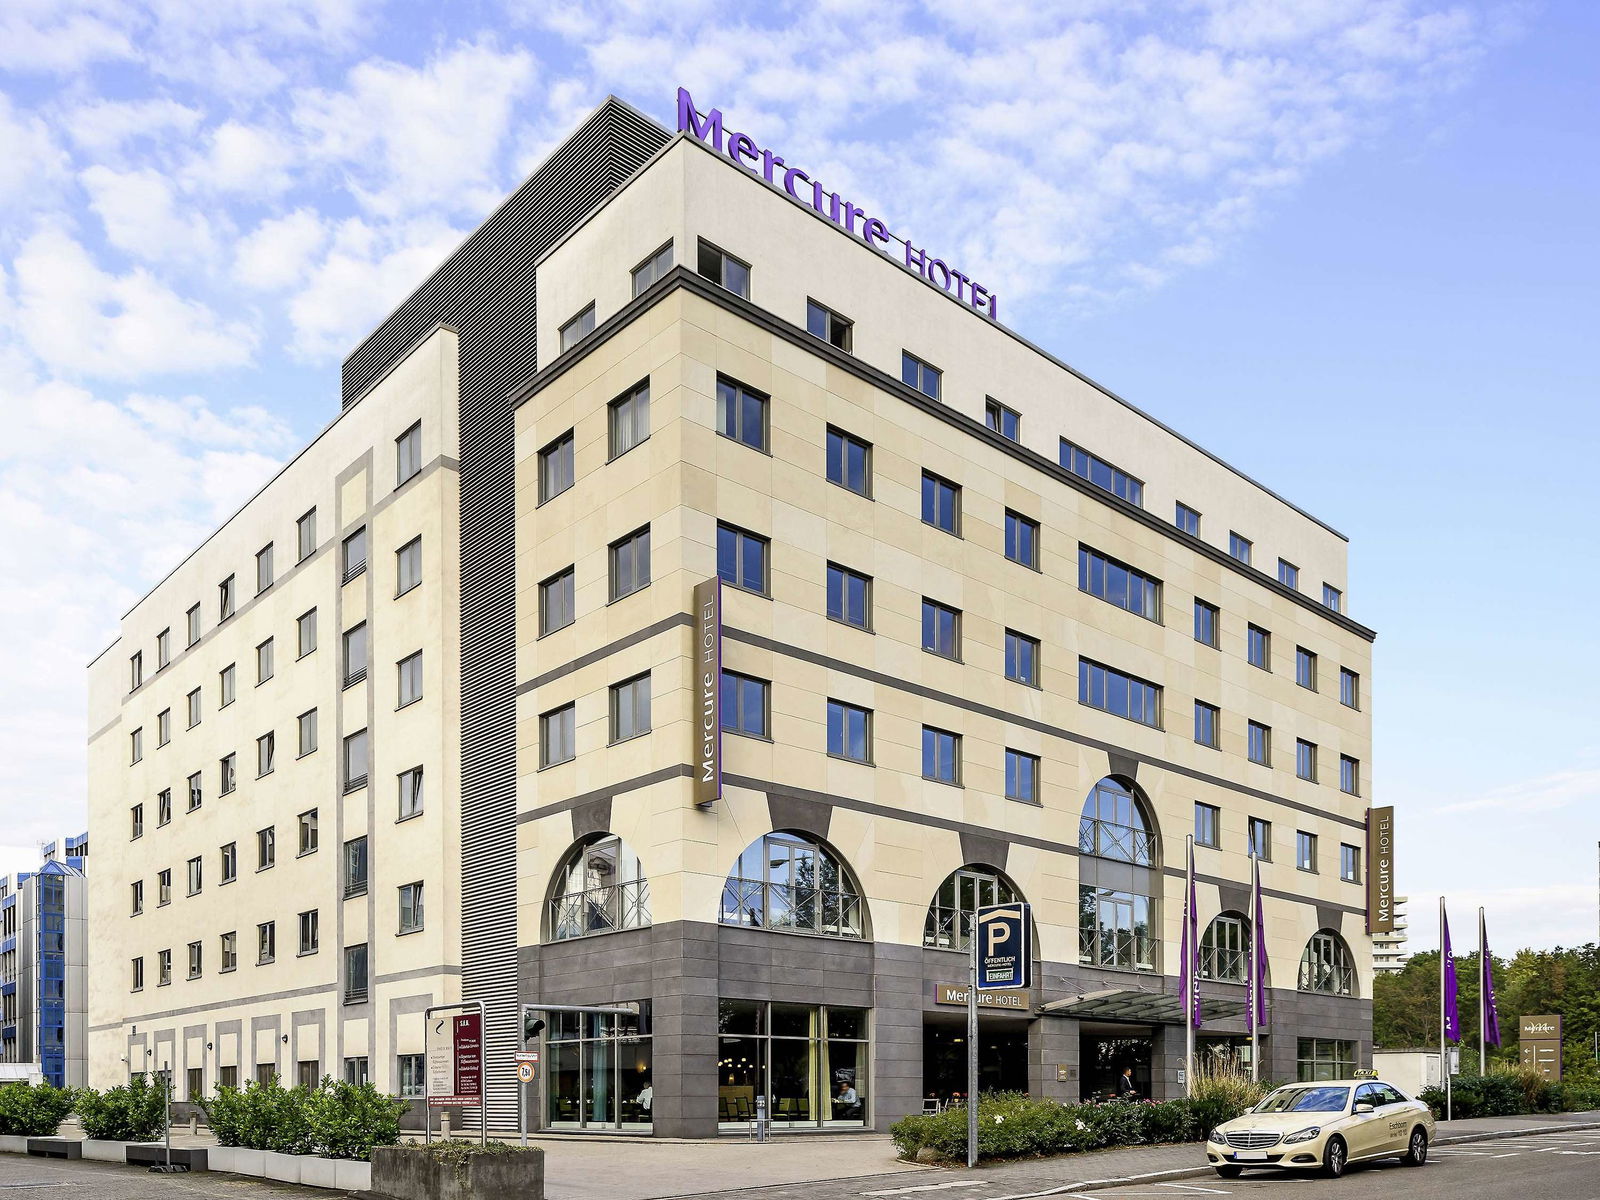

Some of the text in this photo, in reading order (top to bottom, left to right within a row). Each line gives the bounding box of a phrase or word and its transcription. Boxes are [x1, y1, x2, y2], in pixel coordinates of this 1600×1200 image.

[677, 87, 997, 322] Mercure HOTEL
[702, 594, 714, 783] Mercure HOTEL
[1378, 816, 1389, 922] Mercure HOTEL
[988, 922, 1011, 956] P
[985, 956, 1016, 964] ÖFFENTLICH
[989, 972, 1013, 980] EINFAHRT
[946, 989, 1022, 1006] Merure HOTEL
